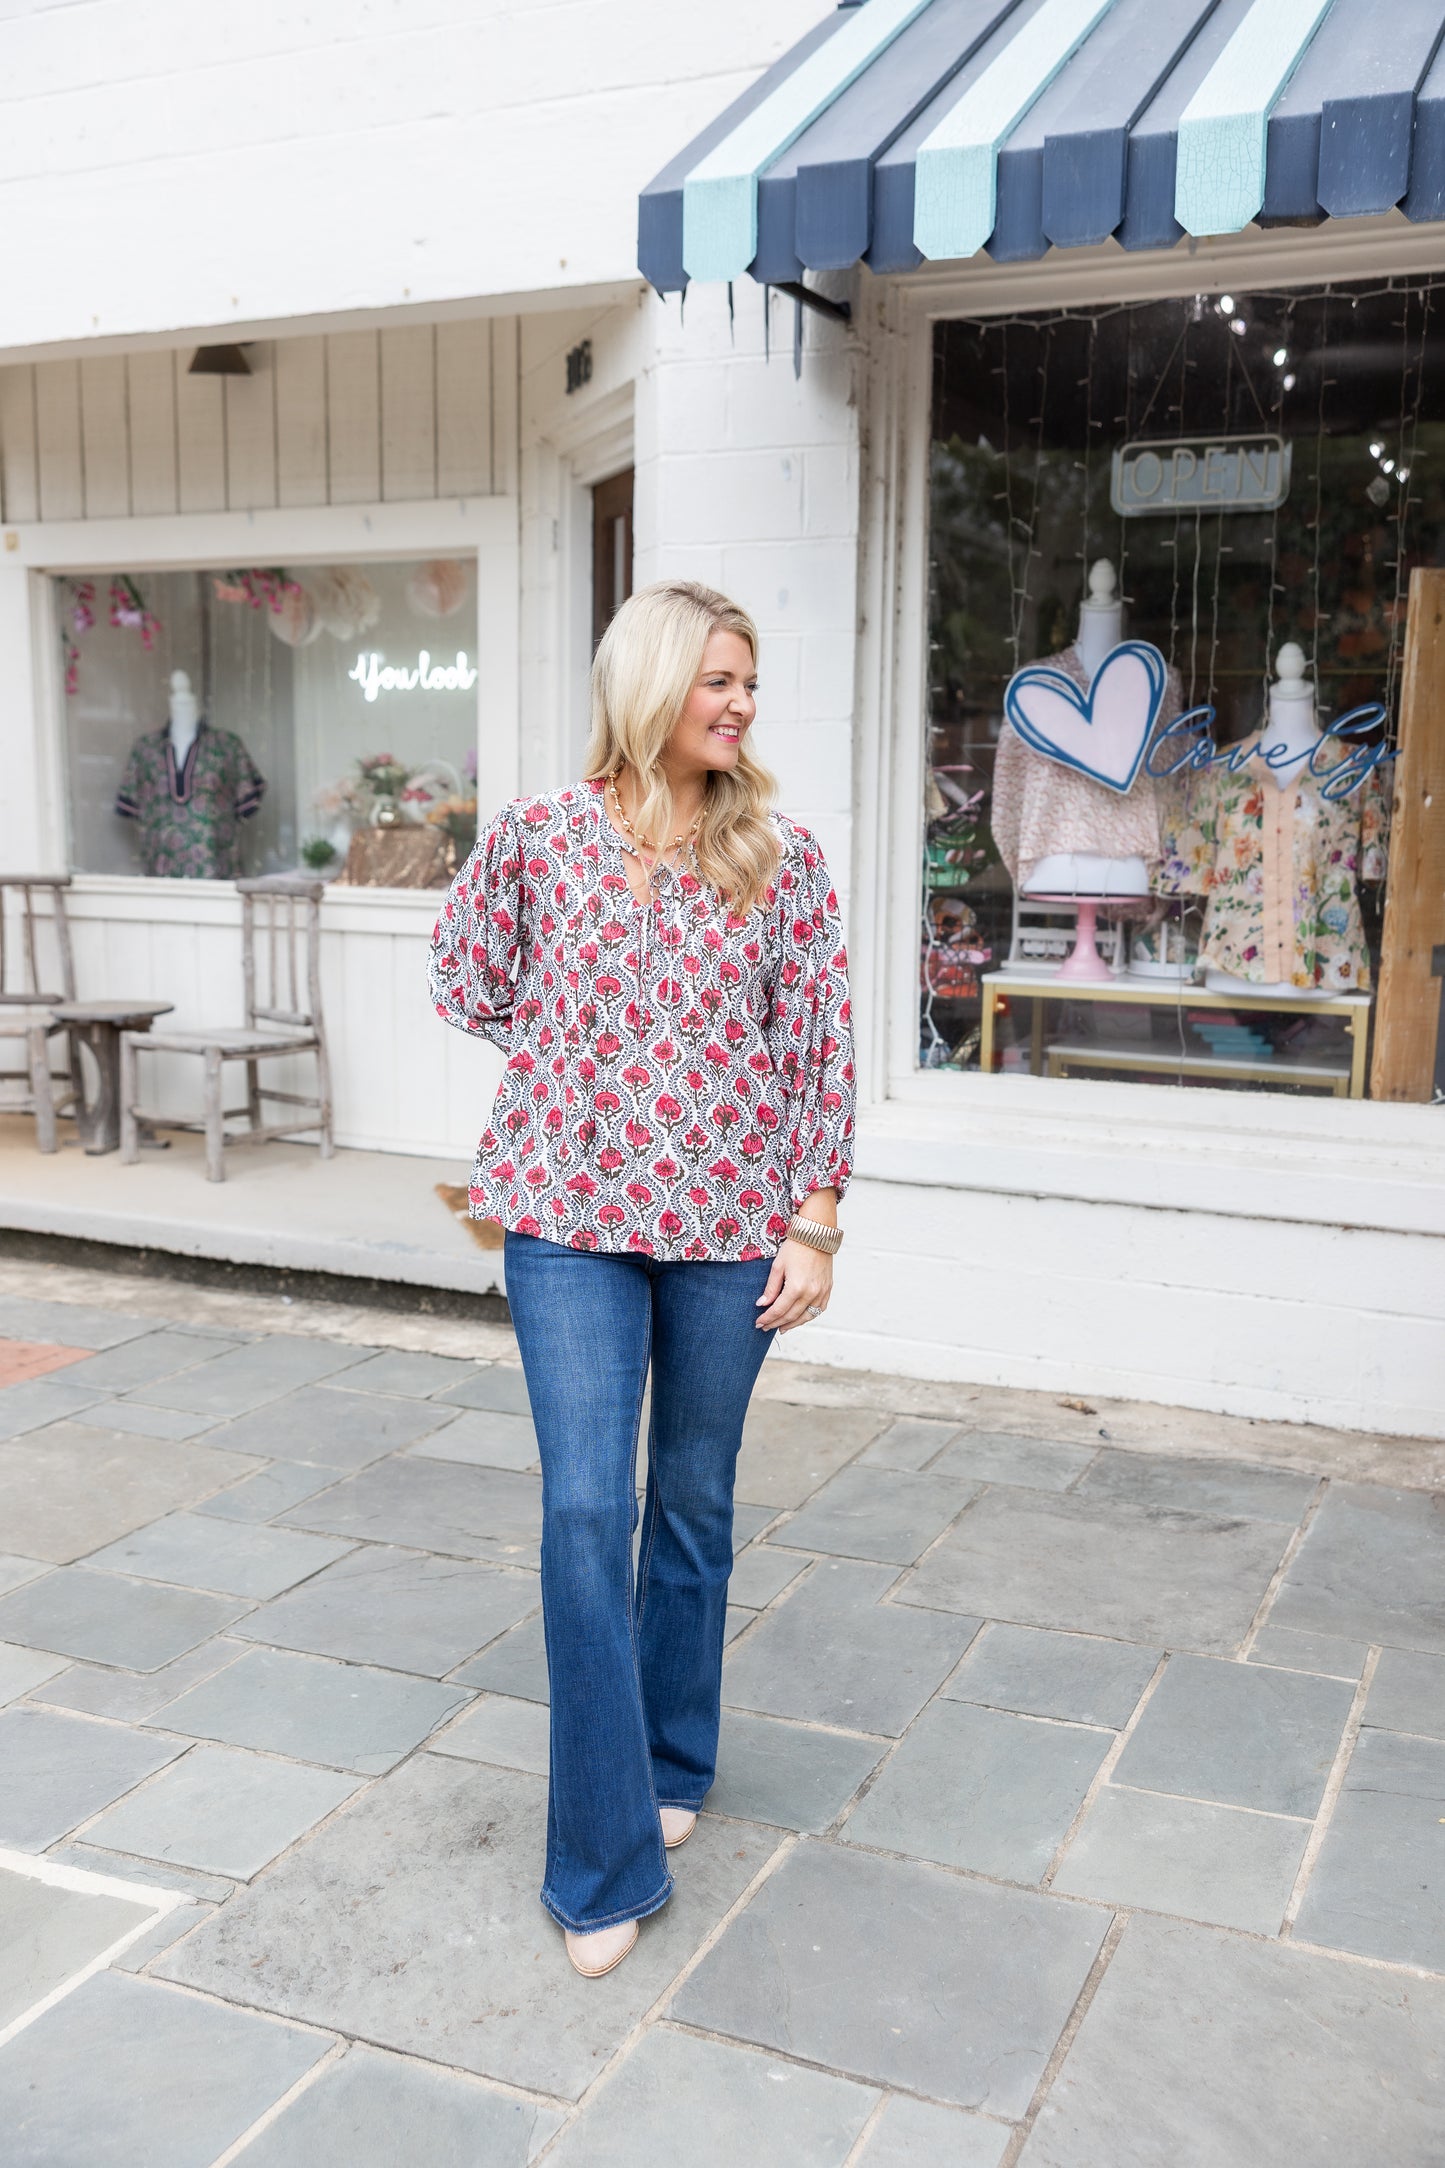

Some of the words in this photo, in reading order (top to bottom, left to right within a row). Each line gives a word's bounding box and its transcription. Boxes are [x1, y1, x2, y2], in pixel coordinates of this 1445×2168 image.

[1132, 444, 1269, 497] OPEN
[348, 653, 419, 702] You
[1145, 702, 1403, 800] lovely
